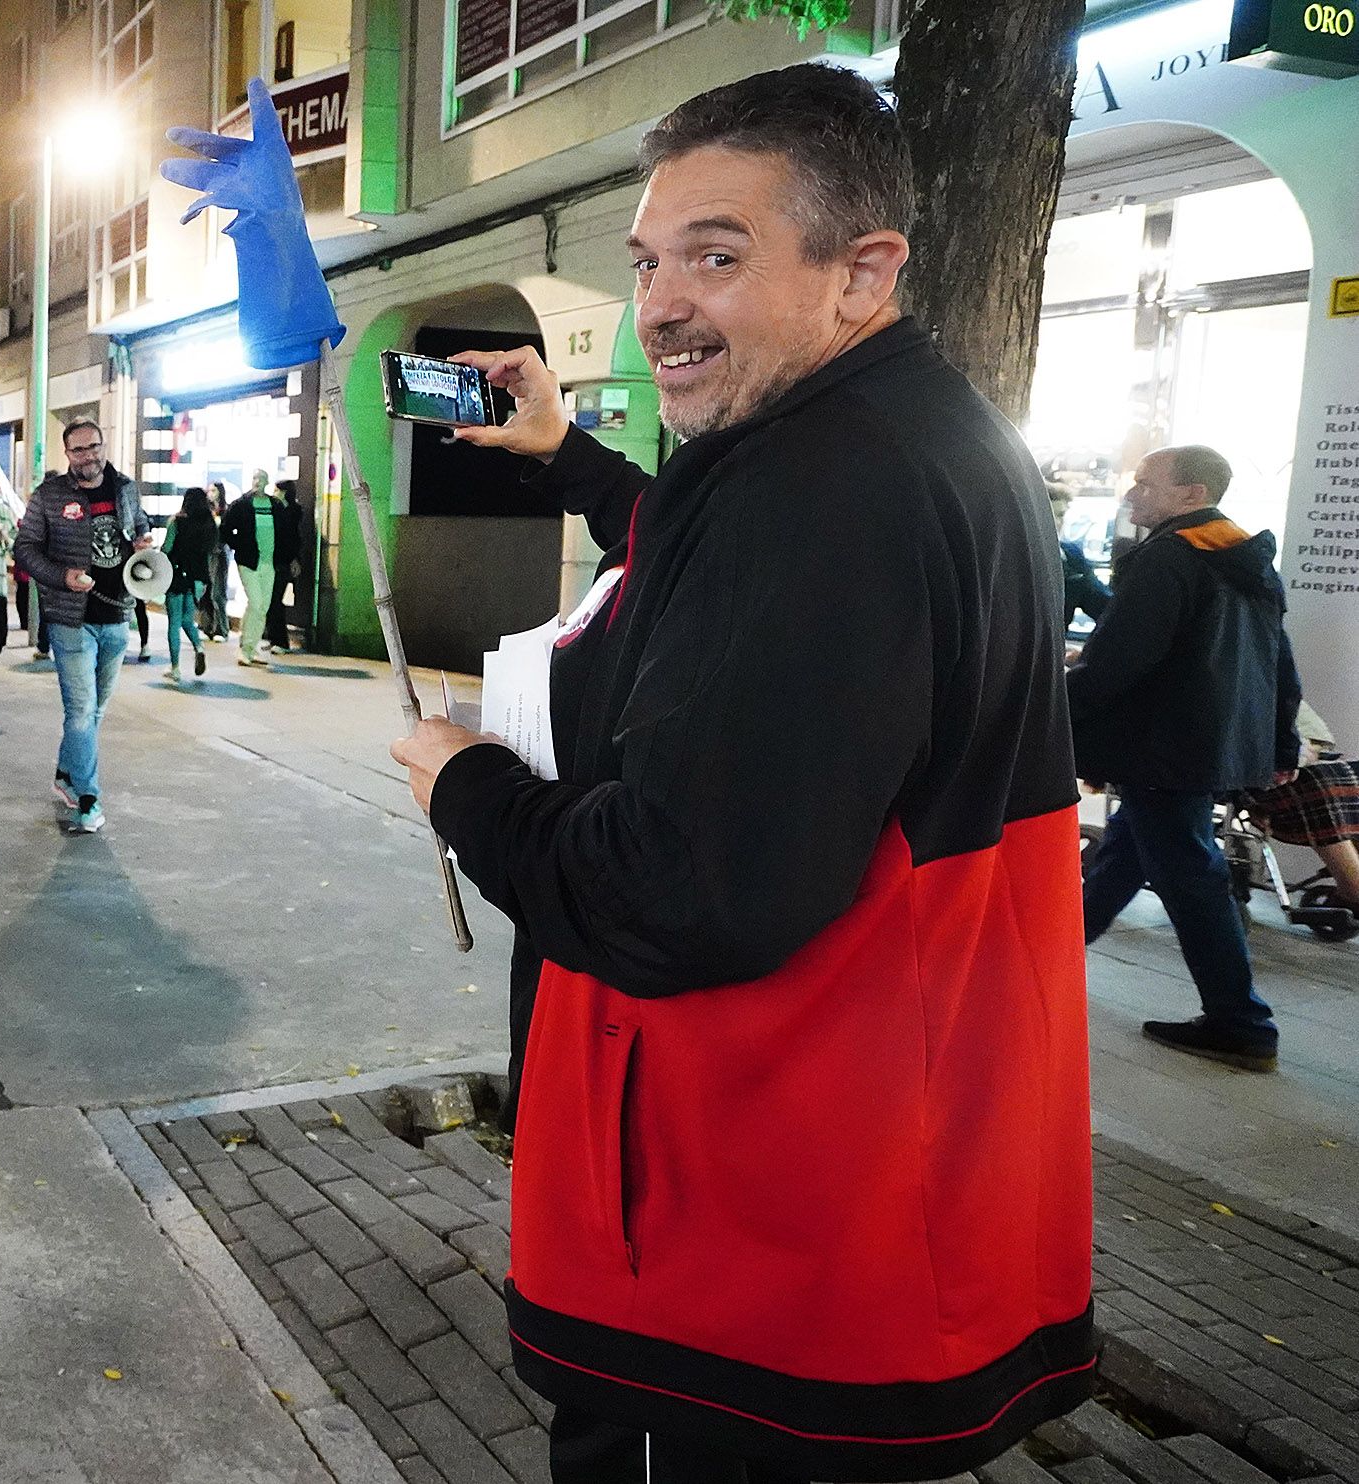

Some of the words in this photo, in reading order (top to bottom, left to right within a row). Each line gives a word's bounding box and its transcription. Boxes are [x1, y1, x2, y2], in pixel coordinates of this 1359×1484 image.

[1304, 3, 1354, 37] ORO
[568, 329, 593, 356] 13
[1325, 421, 1359, 433] Rol
[1307, 510, 1359, 521] Carti
[1290, 579, 1359, 594] Longin
